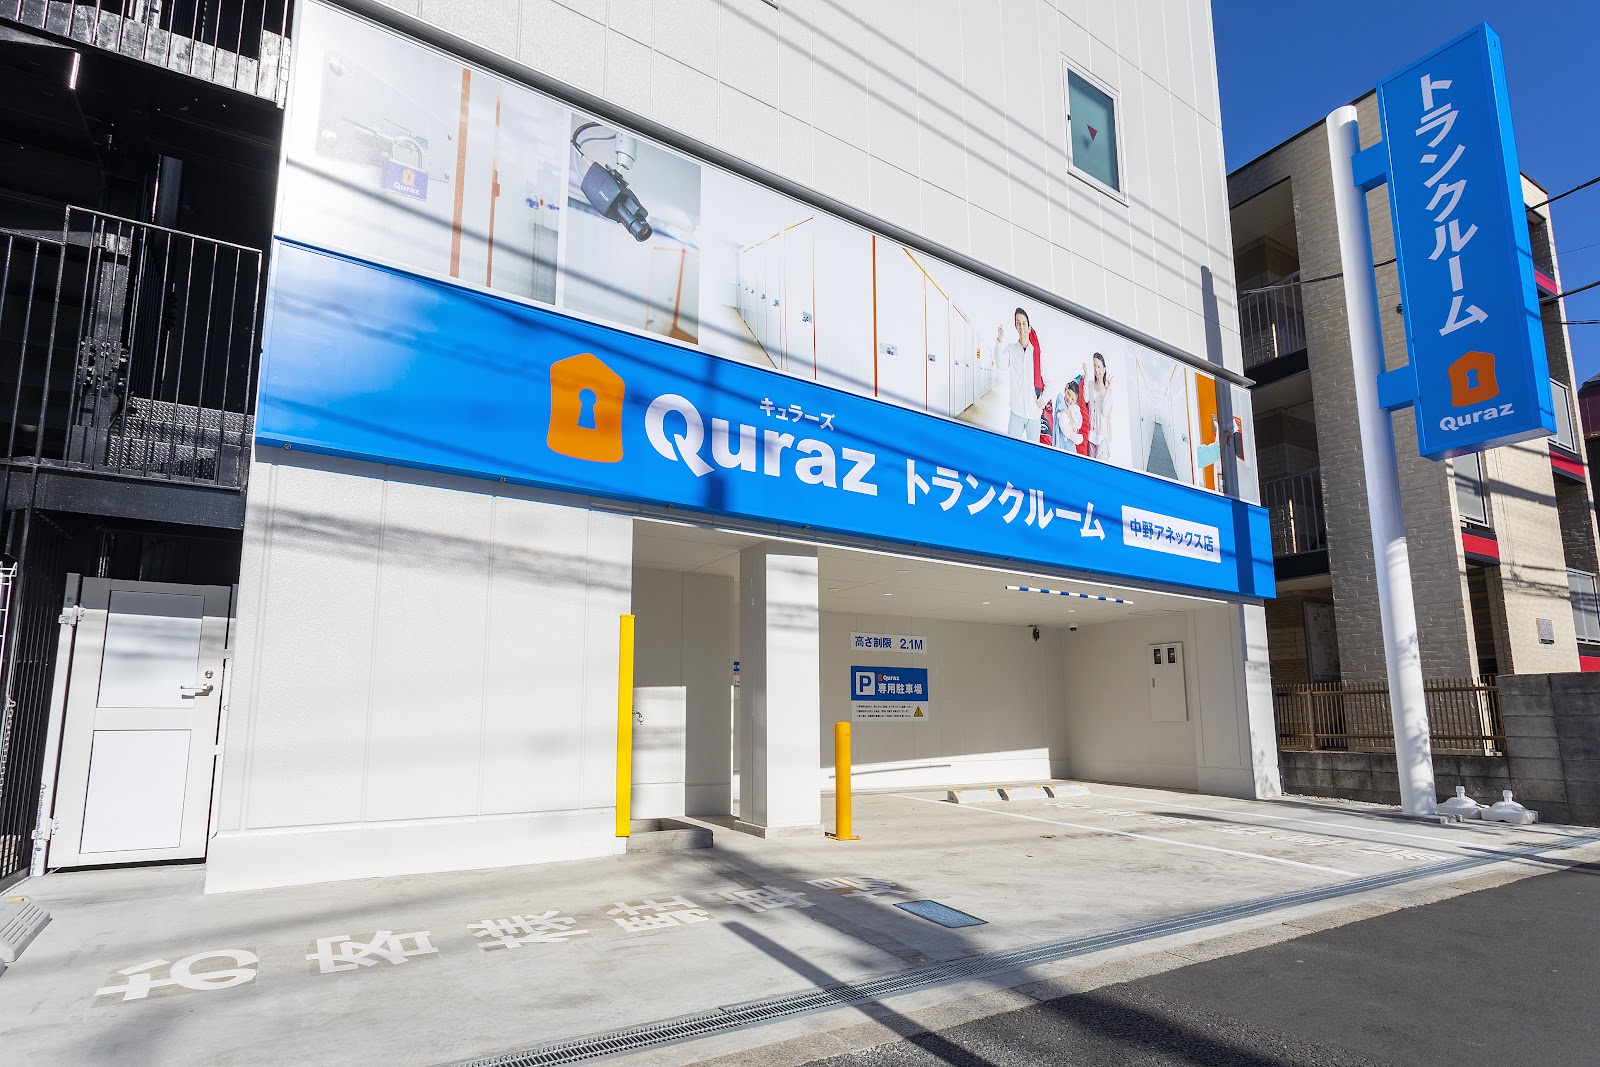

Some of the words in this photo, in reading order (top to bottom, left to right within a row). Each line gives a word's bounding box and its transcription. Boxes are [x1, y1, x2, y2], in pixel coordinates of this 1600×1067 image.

[394, 182, 420, 194] Quraz
[1415, 73, 1489, 337] トランクルーム
[759, 397, 836, 432] キュラーズ
[1439, 402, 1514, 432] Quraz
[644, 393, 878, 497] Quraz
[906, 458, 1106, 541] トランクルーム
[1129, 517, 1215, 553] 中野アネックス店
[855, 636, 892, 648] 高さ制限
[899, 638, 923, 650] 2.1M
[859, 675, 872, 693] P
[877, 683, 922, 694] 専用駐車場
